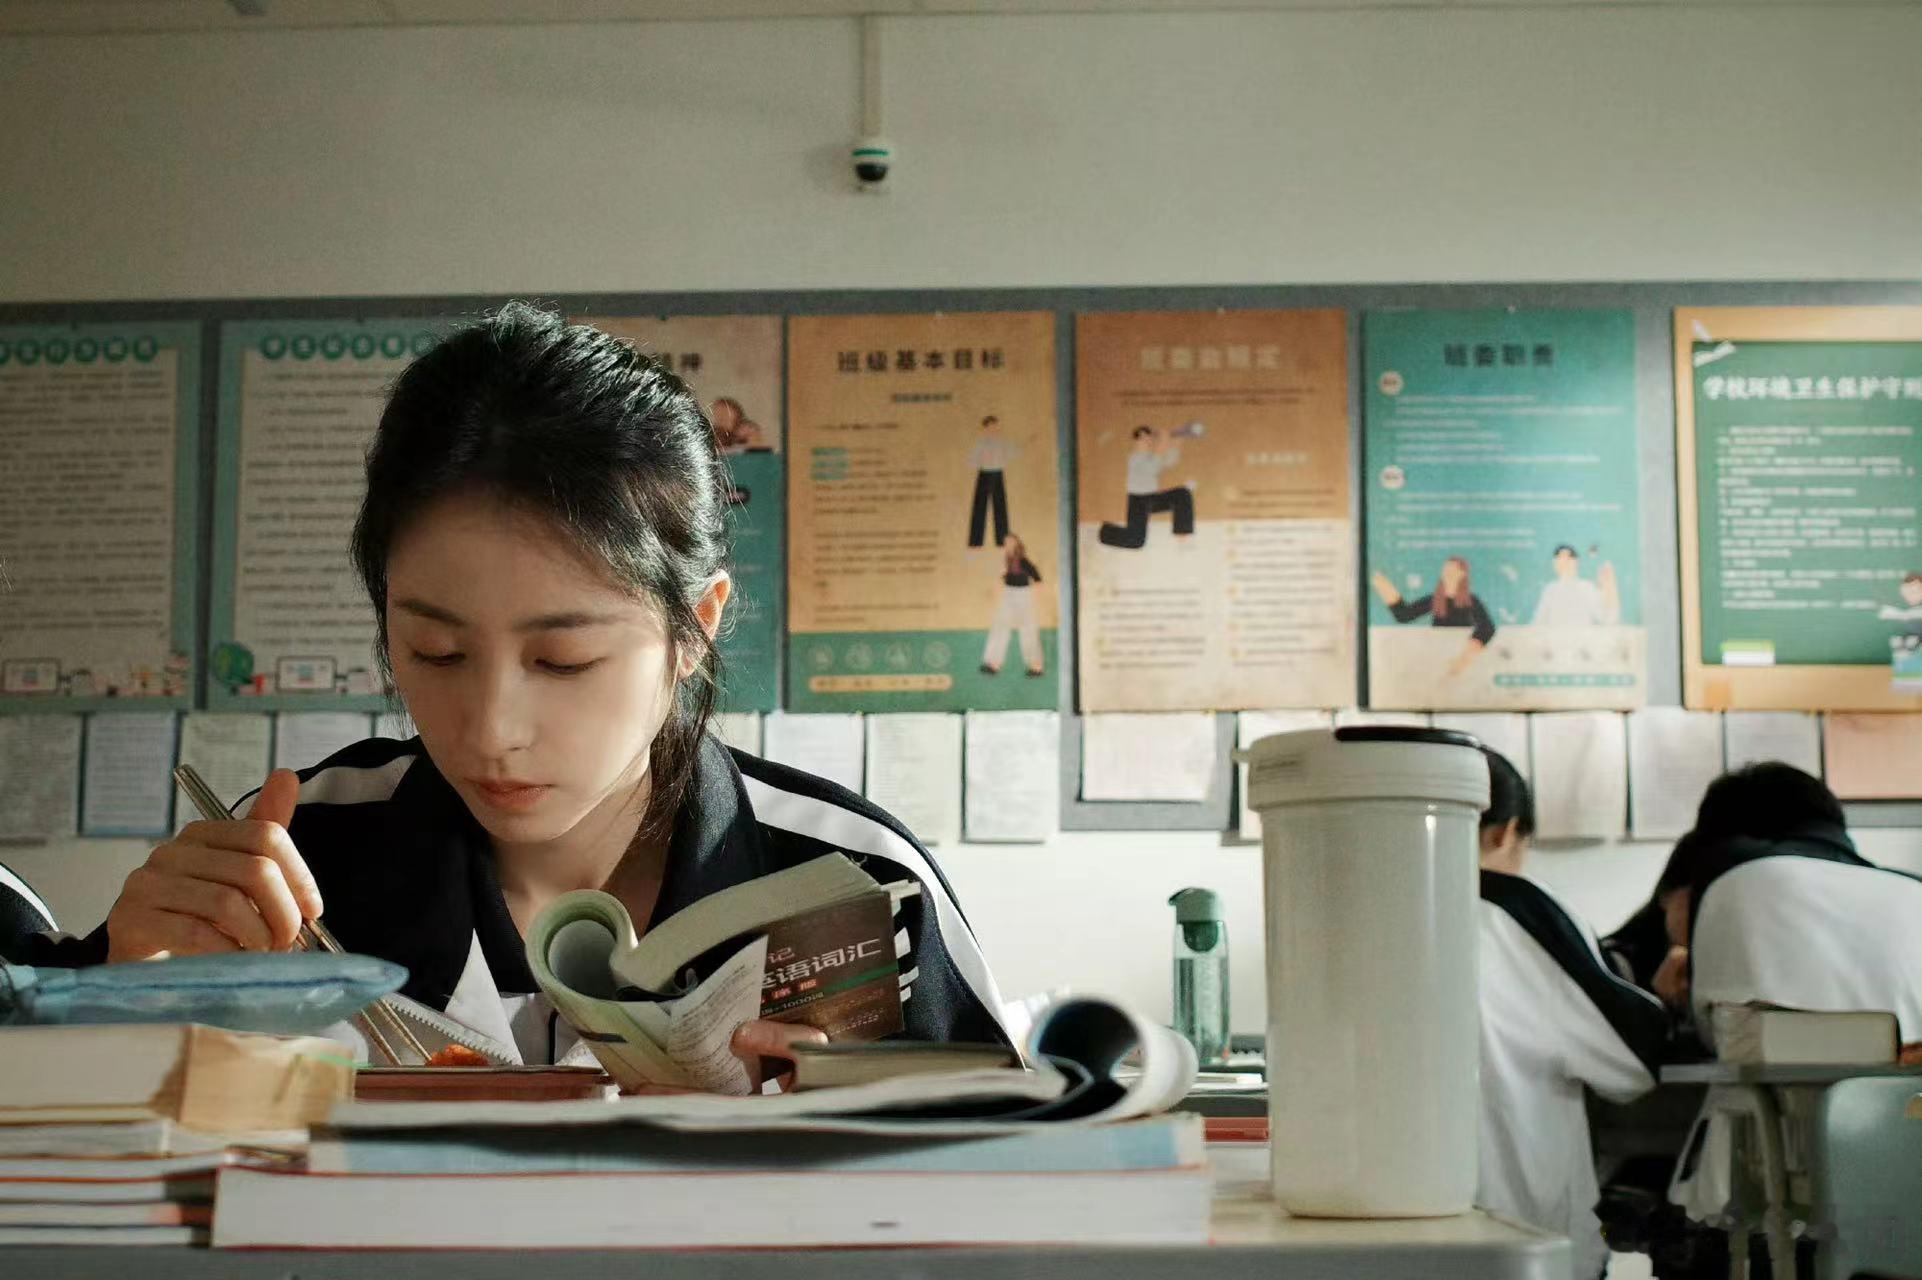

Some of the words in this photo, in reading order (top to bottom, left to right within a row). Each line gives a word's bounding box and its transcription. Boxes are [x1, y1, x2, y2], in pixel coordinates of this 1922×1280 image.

[838, 349, 1004, 372] 班级基本目标
